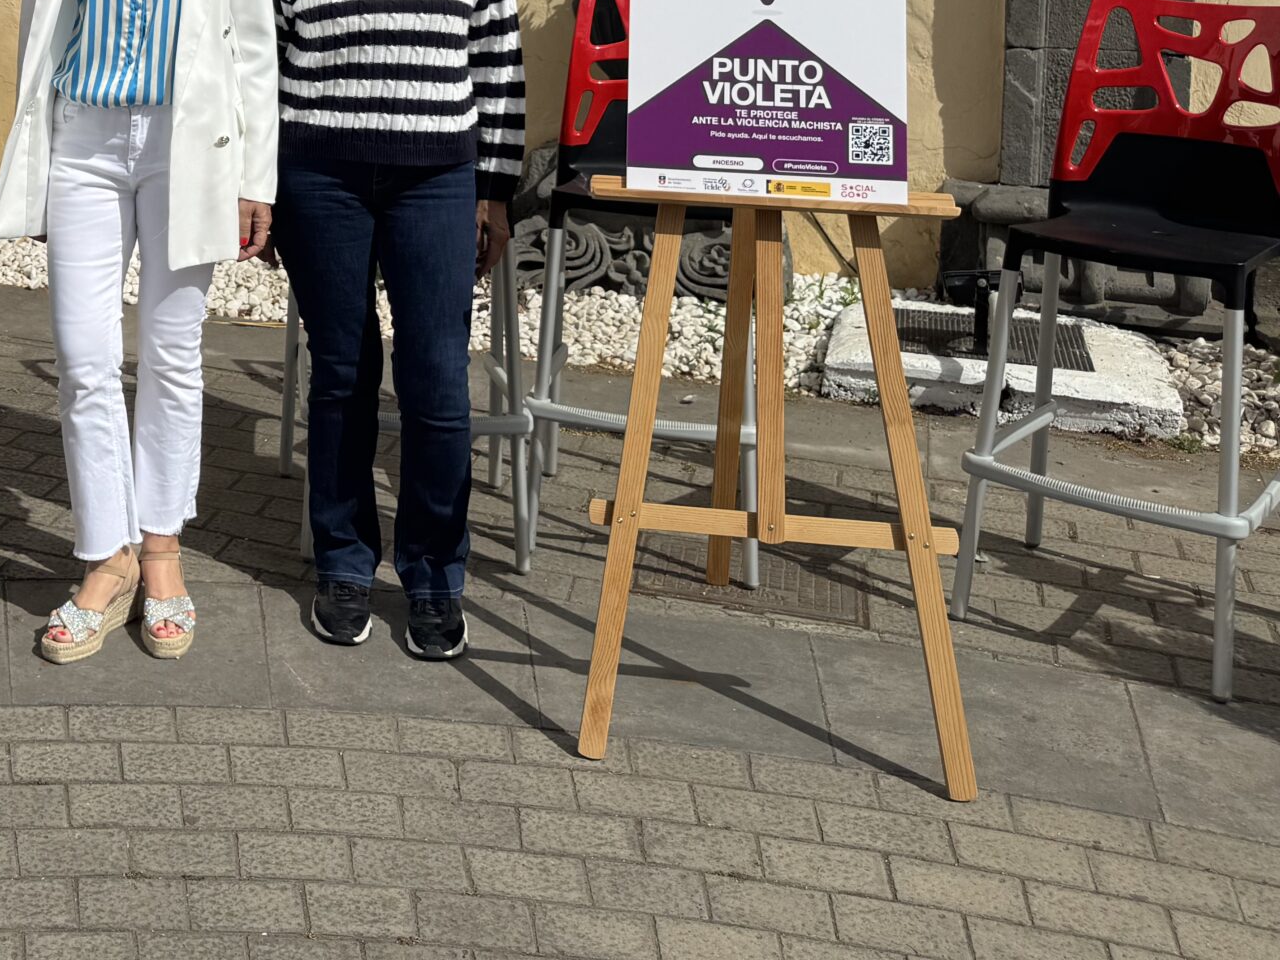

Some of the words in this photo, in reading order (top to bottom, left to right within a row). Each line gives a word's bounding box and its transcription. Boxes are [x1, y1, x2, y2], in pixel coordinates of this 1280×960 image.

[712, 57, 823, 84] PUNTO
[702, 81, 832, 109] VIOLETA
[735, 109, 748, 118] TE
[750, 110, 799, 120] PROTEGE
[692, 116, 718, 125] ANTE
[720, 118, 734, 126] LA
[736, 118, 789, 128] VIOLENCIA
[791, 121, 843, 130] MACHISTA
[710, 130, 726, 138] Pide
[727, 132, 750, 140] ayuda.
[752, 132, 768, 140] Aquí
[777, 134, 824, 142] escuchamos.
[712, 159, 744, 167] #NOESNO
[783, 162, 827, 171] #PuntoVioleta
